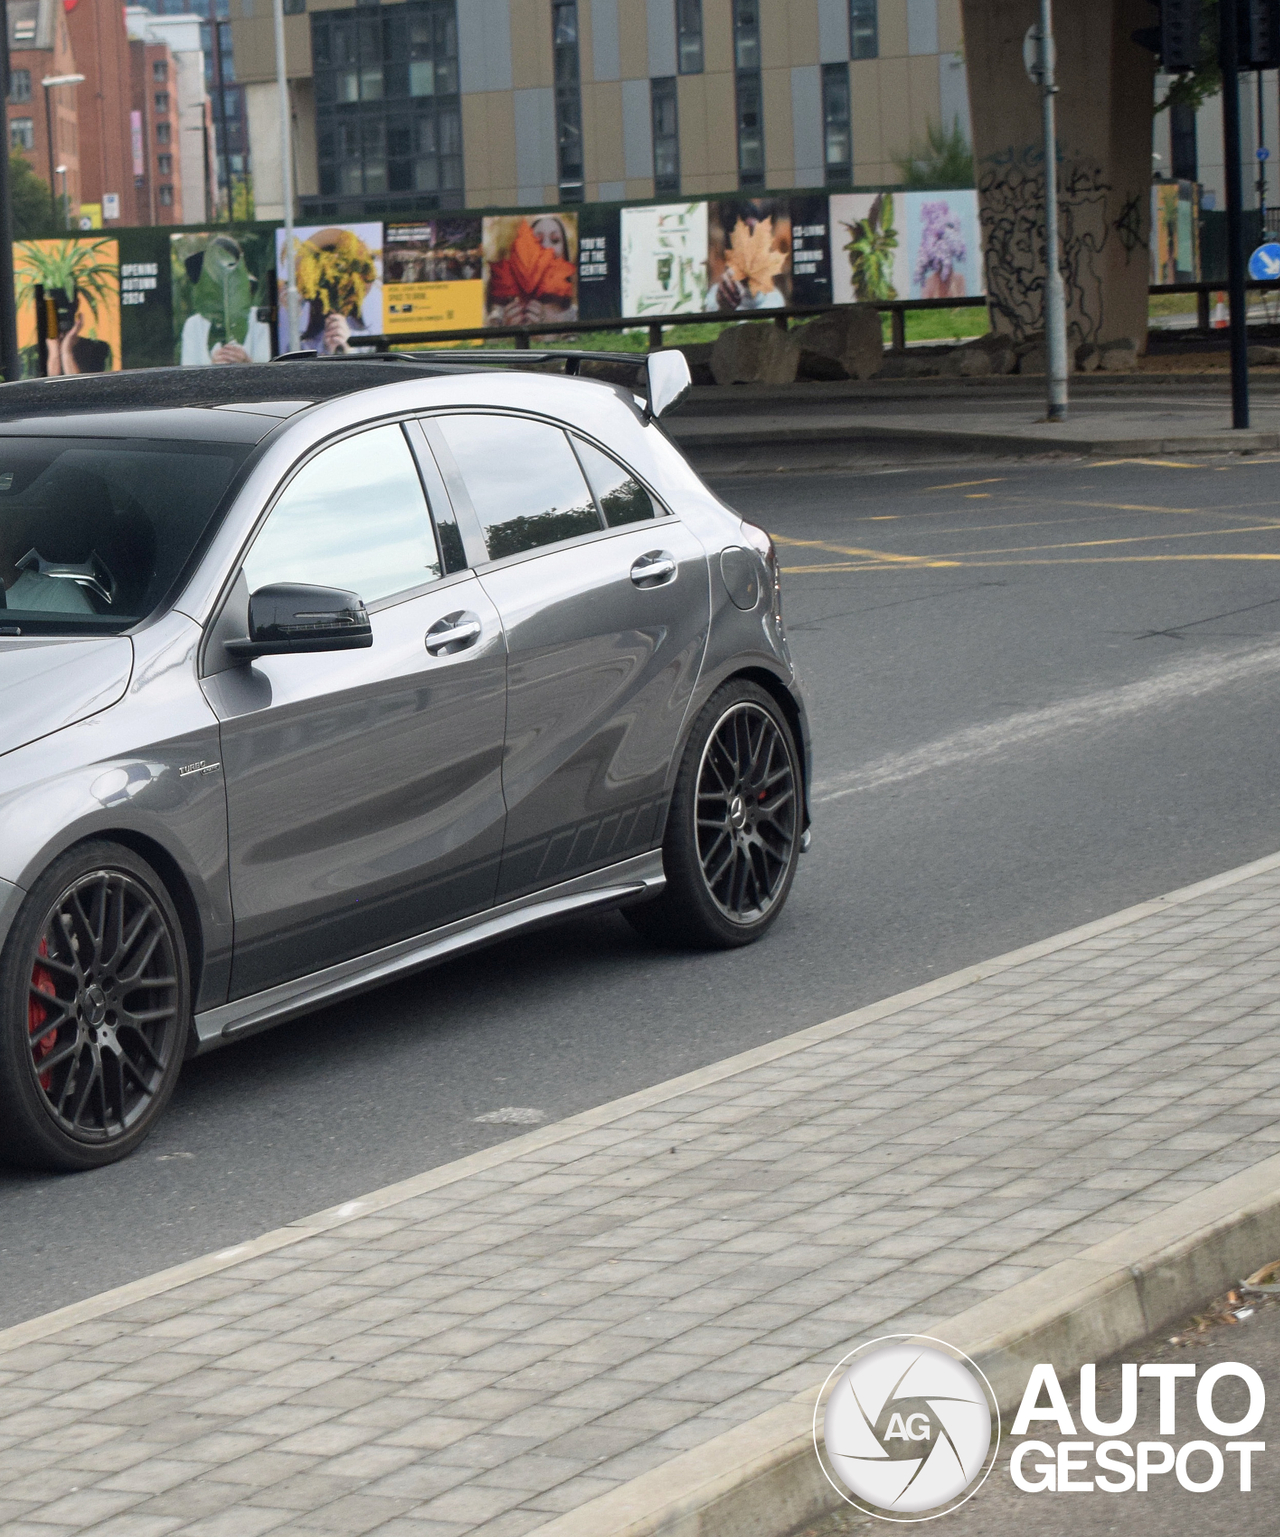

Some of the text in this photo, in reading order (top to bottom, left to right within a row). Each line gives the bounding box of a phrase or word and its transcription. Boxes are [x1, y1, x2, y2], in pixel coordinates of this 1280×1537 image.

[580, 250, 606, 263] AT THE
[121, 263, 158, 277] OPENING
[580, 263, 608, 277] CENTRE
[122, 277, 157, 290] AUTUMN
[179, 760, 206, 774] TURBO
